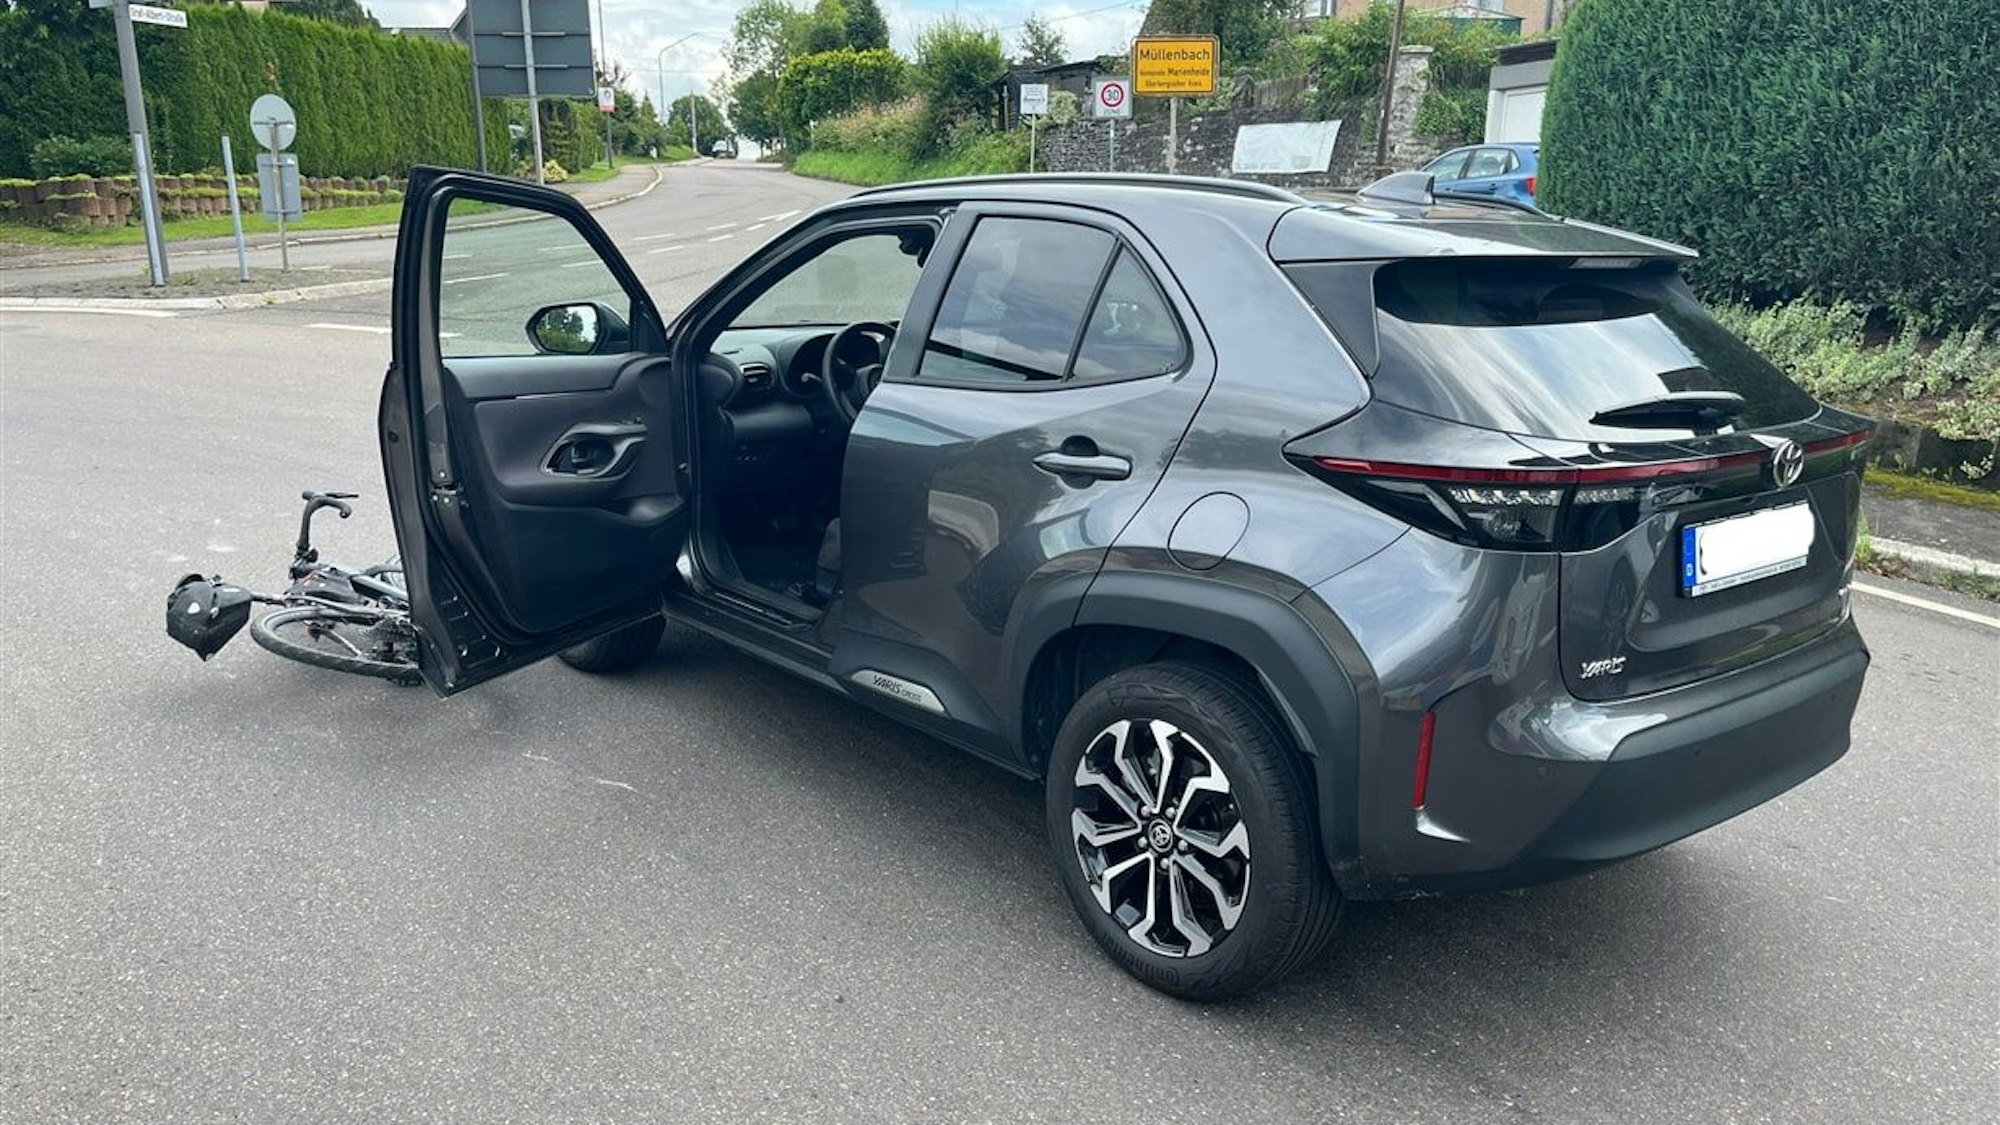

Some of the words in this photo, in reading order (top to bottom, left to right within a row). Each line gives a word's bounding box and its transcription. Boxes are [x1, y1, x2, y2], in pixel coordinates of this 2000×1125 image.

[1140, 48, 1210, 61] Müllenbach
[1106, 89, 1119, 101] 30
[1580, 656, 1627, 679] YARIS
[873, 675, 902, 694] YARIS
